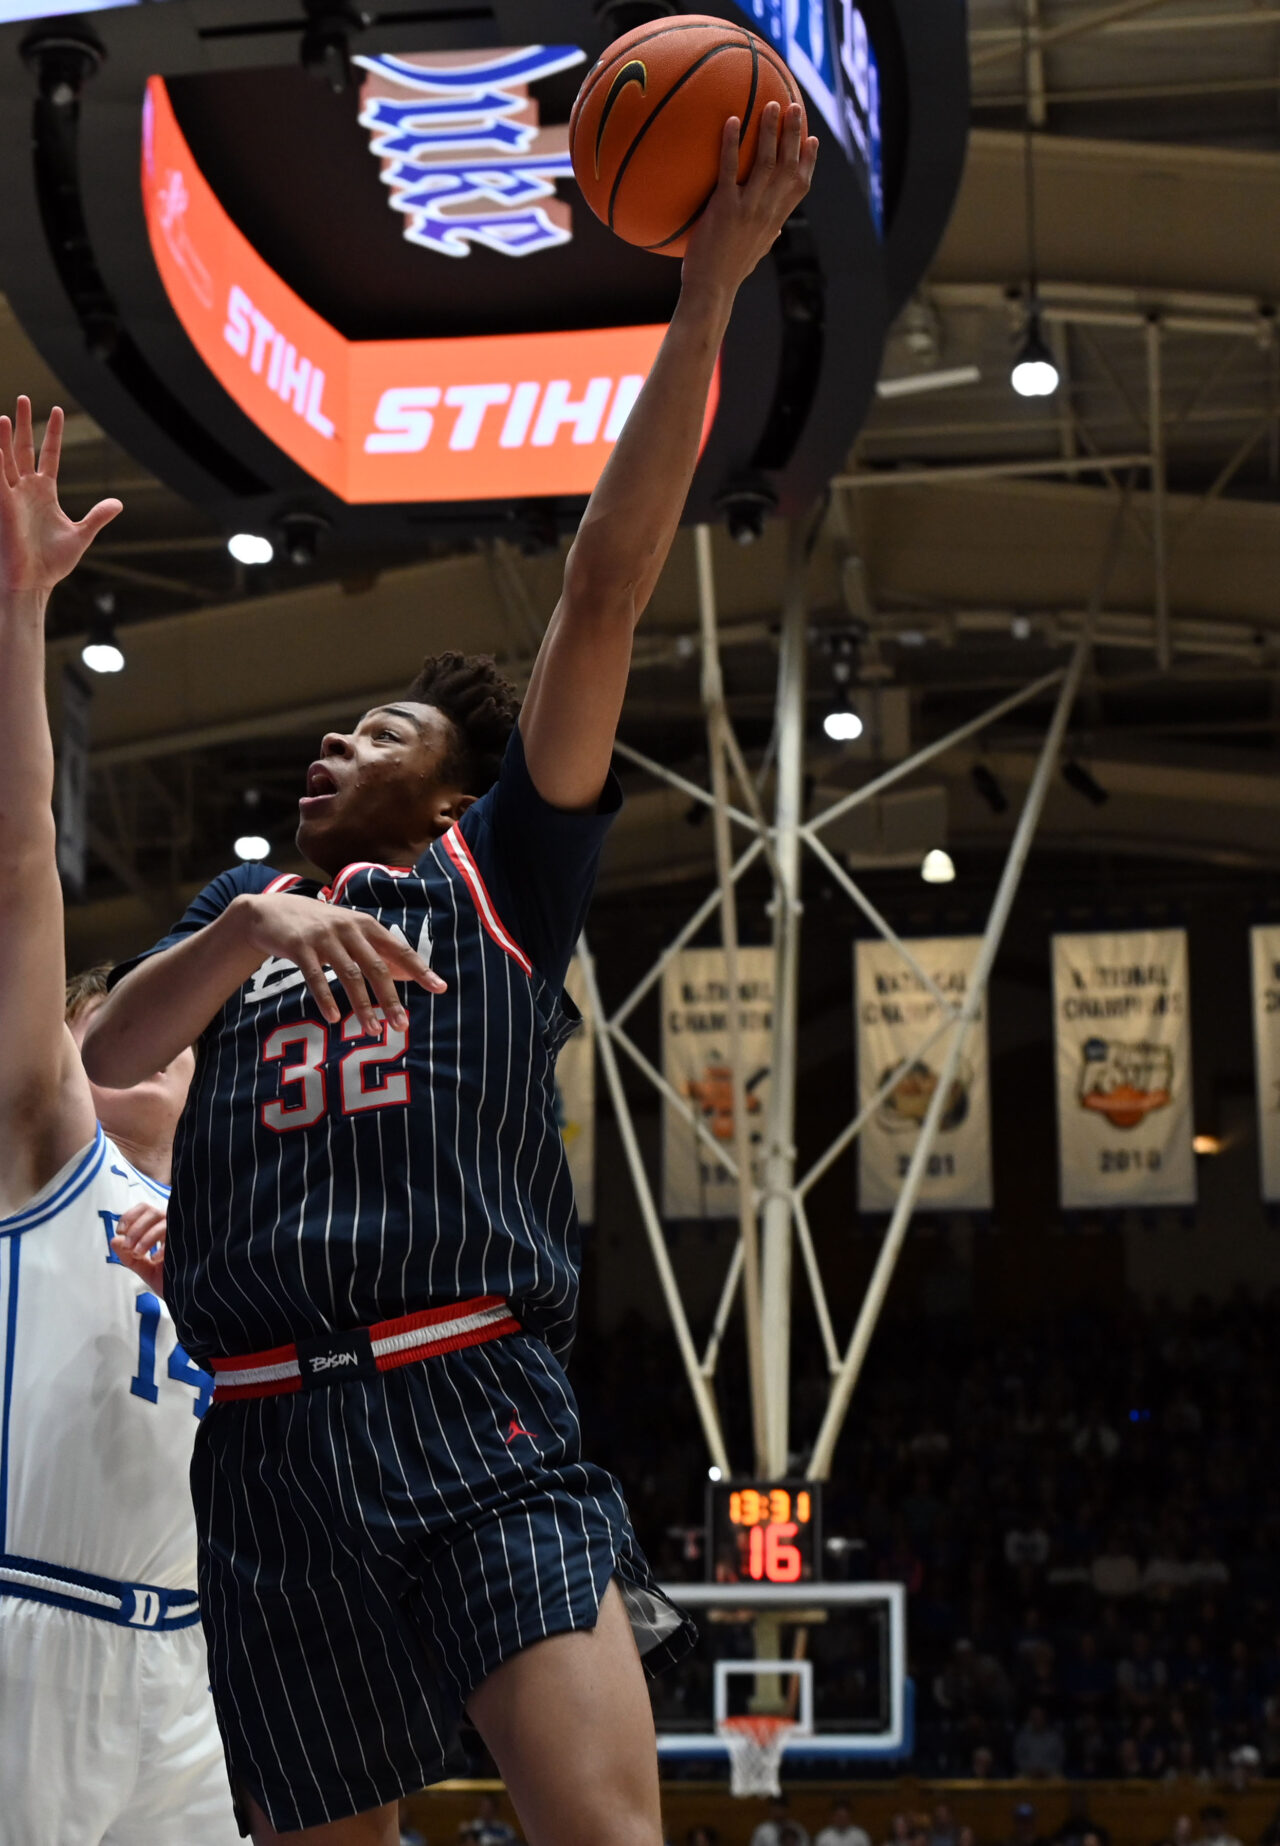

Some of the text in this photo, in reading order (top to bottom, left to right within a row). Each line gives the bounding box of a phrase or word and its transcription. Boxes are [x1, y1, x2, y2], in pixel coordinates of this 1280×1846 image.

[223, 284, 335, 440] STIHL
[261, 1004, 411, 1133] 32
[898, 1153, 955, 1177] 201
[729, 1489, 811, 1526] 13:31
[749, 1522, 801, 1583] 16
